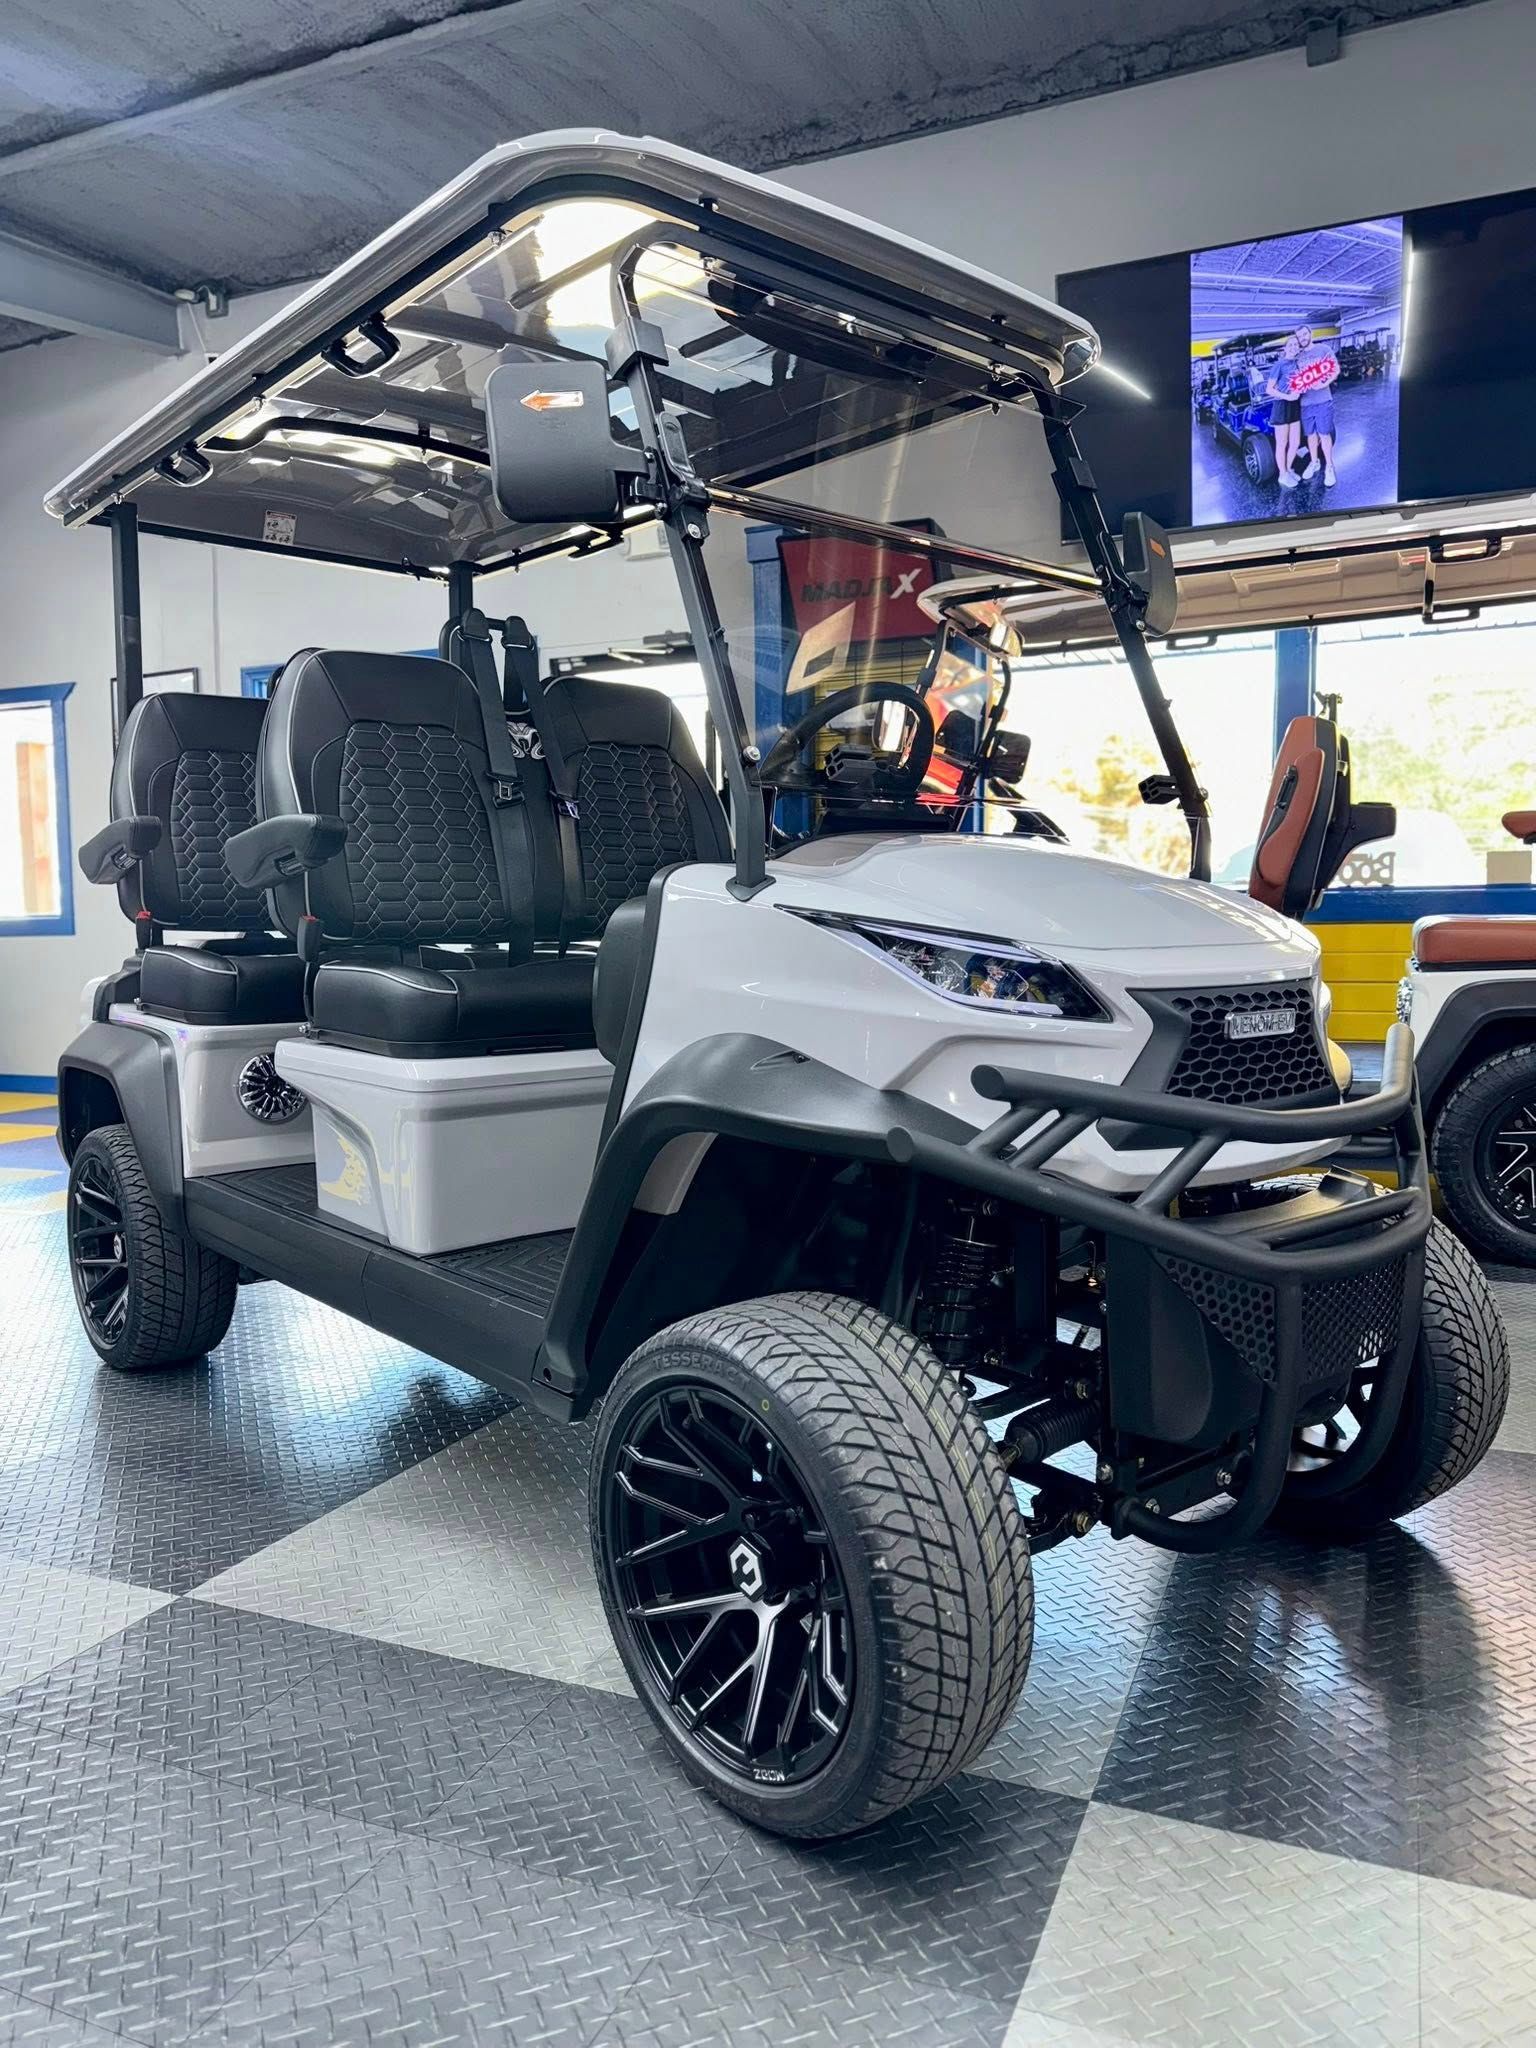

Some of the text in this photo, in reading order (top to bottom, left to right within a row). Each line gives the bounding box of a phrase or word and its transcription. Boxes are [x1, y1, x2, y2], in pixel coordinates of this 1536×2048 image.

[1294, 361, 1331, 389] SOLD
[801, 568, 922, 602] MADJAX
[653, 1351, 753, 1392] TESSERACT
